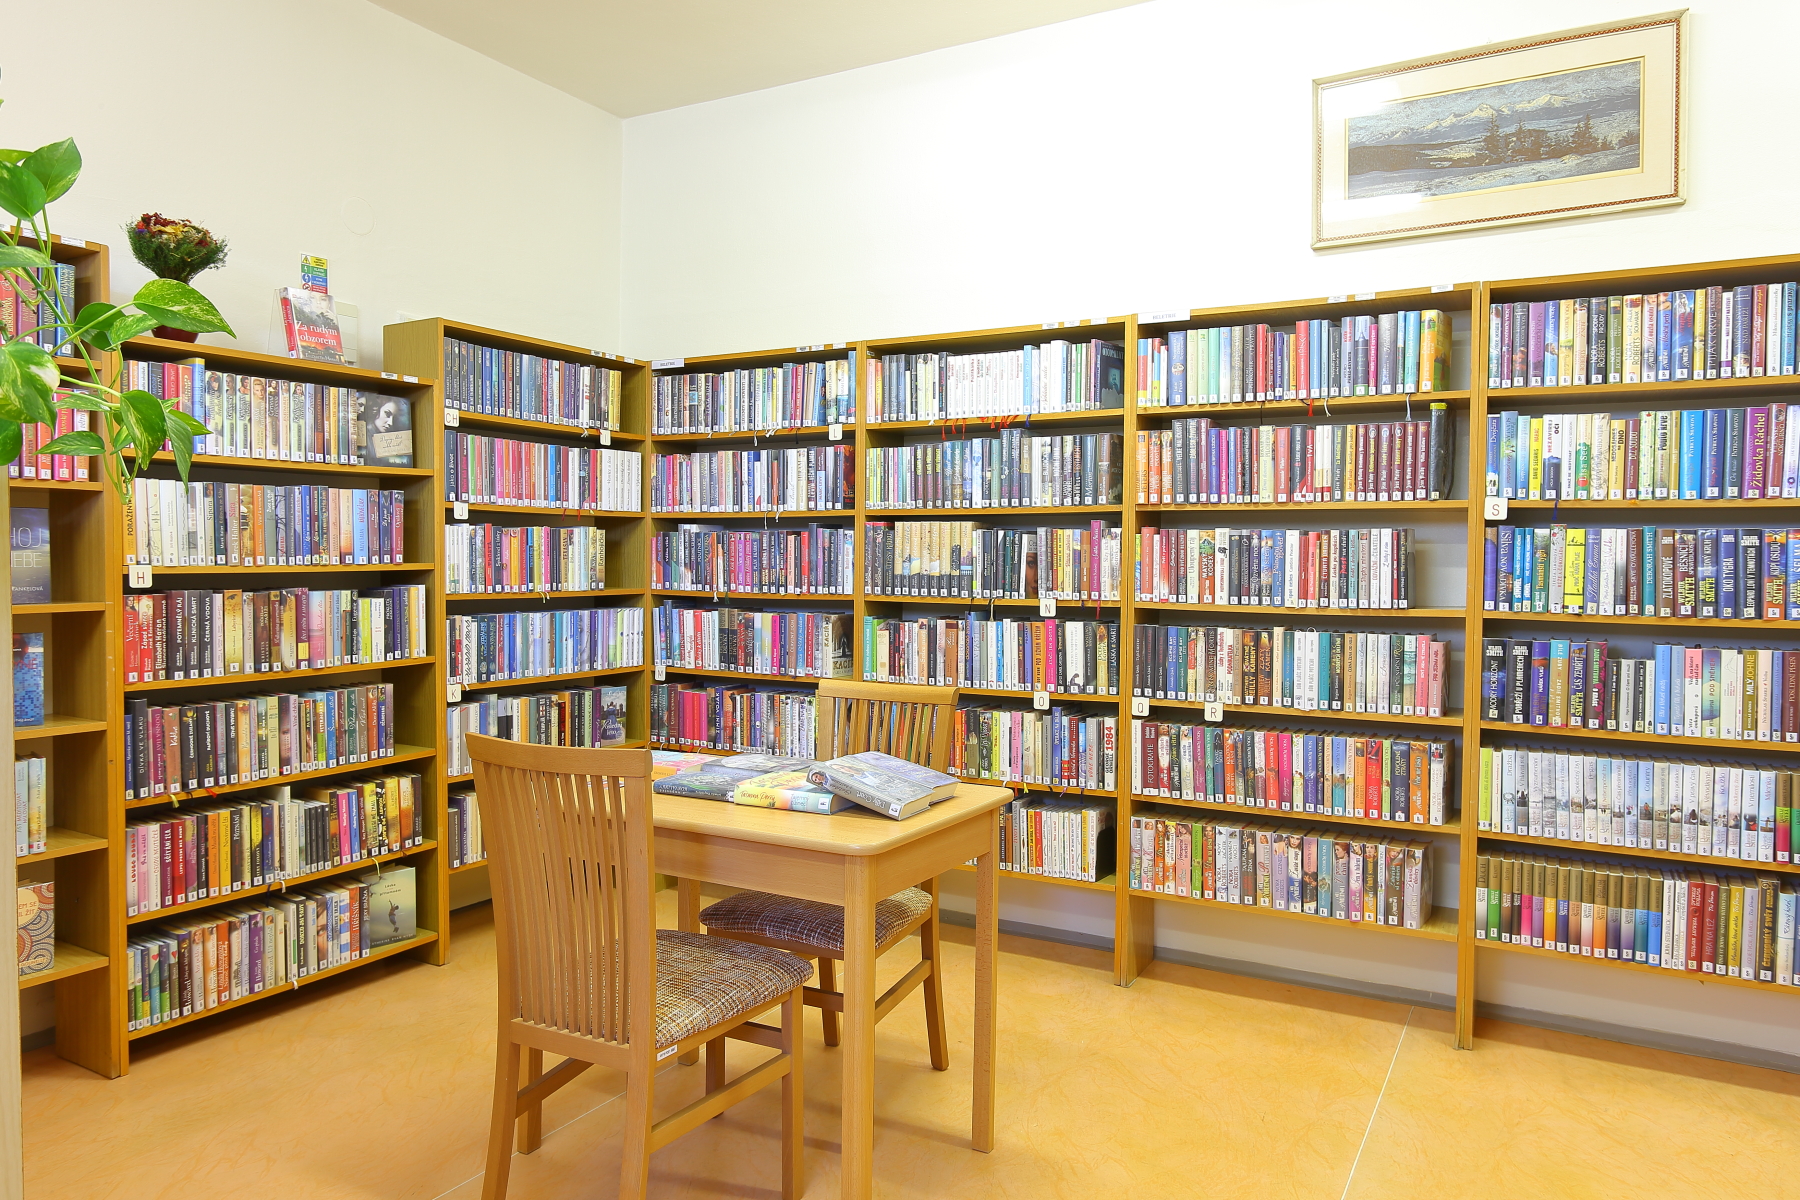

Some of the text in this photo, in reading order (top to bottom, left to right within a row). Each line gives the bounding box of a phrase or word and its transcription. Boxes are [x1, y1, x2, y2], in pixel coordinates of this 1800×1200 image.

[297, 321, 338, 336] Za rudým
[1707, 312, 1717, 366] PIJÁK KRVE
[300, 333, 337, 347] obzorem
[1590, 344, 1598, 363] NORA
[1625, 342, 1633, 361] NORA
[446, 412, 458, 424] CH
[833, 428, 838, 438] L
[1657, 415, 1667, 450] Pouto krve
[1750, 413, 1765, 487] Židovka Ráchel
[1579, 446, 1587, 480] Lisa See
[459, 506, 464, 517] J
[1491, 503, 1500, 517] S
[1678, 545, 1688, 571] BĚSNÍCÍ
[1770, 541, 1780, 575] KOPÍ OSUDU
[137, 571, 145, 585] H
[1535, 550, 1545, 589] Tasmánští tygři
[1587, 544, 1598, 600] Sladká Emma
[1662, 557, 1673, 598] ZLATOKOPOVÉ
[1723, 558, 1733, 591] OKO TYGRA
[1678, 581, 1686, 603] WILBUR
[1686, 577, 1694, 606] SMITH
[1706, 578, 1715, 601] SMITH
[1774, 580, 1783, 604] SMITH
[1044, 603, 1051, 614] N
[126, 615, 134, 641] Večerní
[1573, 657, 1583, 689] ČAS ZEMŘÍT
[451, 688, 457, 700] K
[1745, 680, 1754, 695] MILÝ
[1038, 697, 1044, 707] O
[1137, 702, 1144, 713] Q
[1210, 706, 1217, 719] R
[1105, 726, 1113, 751] 1984
[1478, 863, 1486, 883] DUCH
[1707, 932, 1713, 942] NA
[1762, 909, 1772, 966] ČERNOBÍLÝ SVĚT
